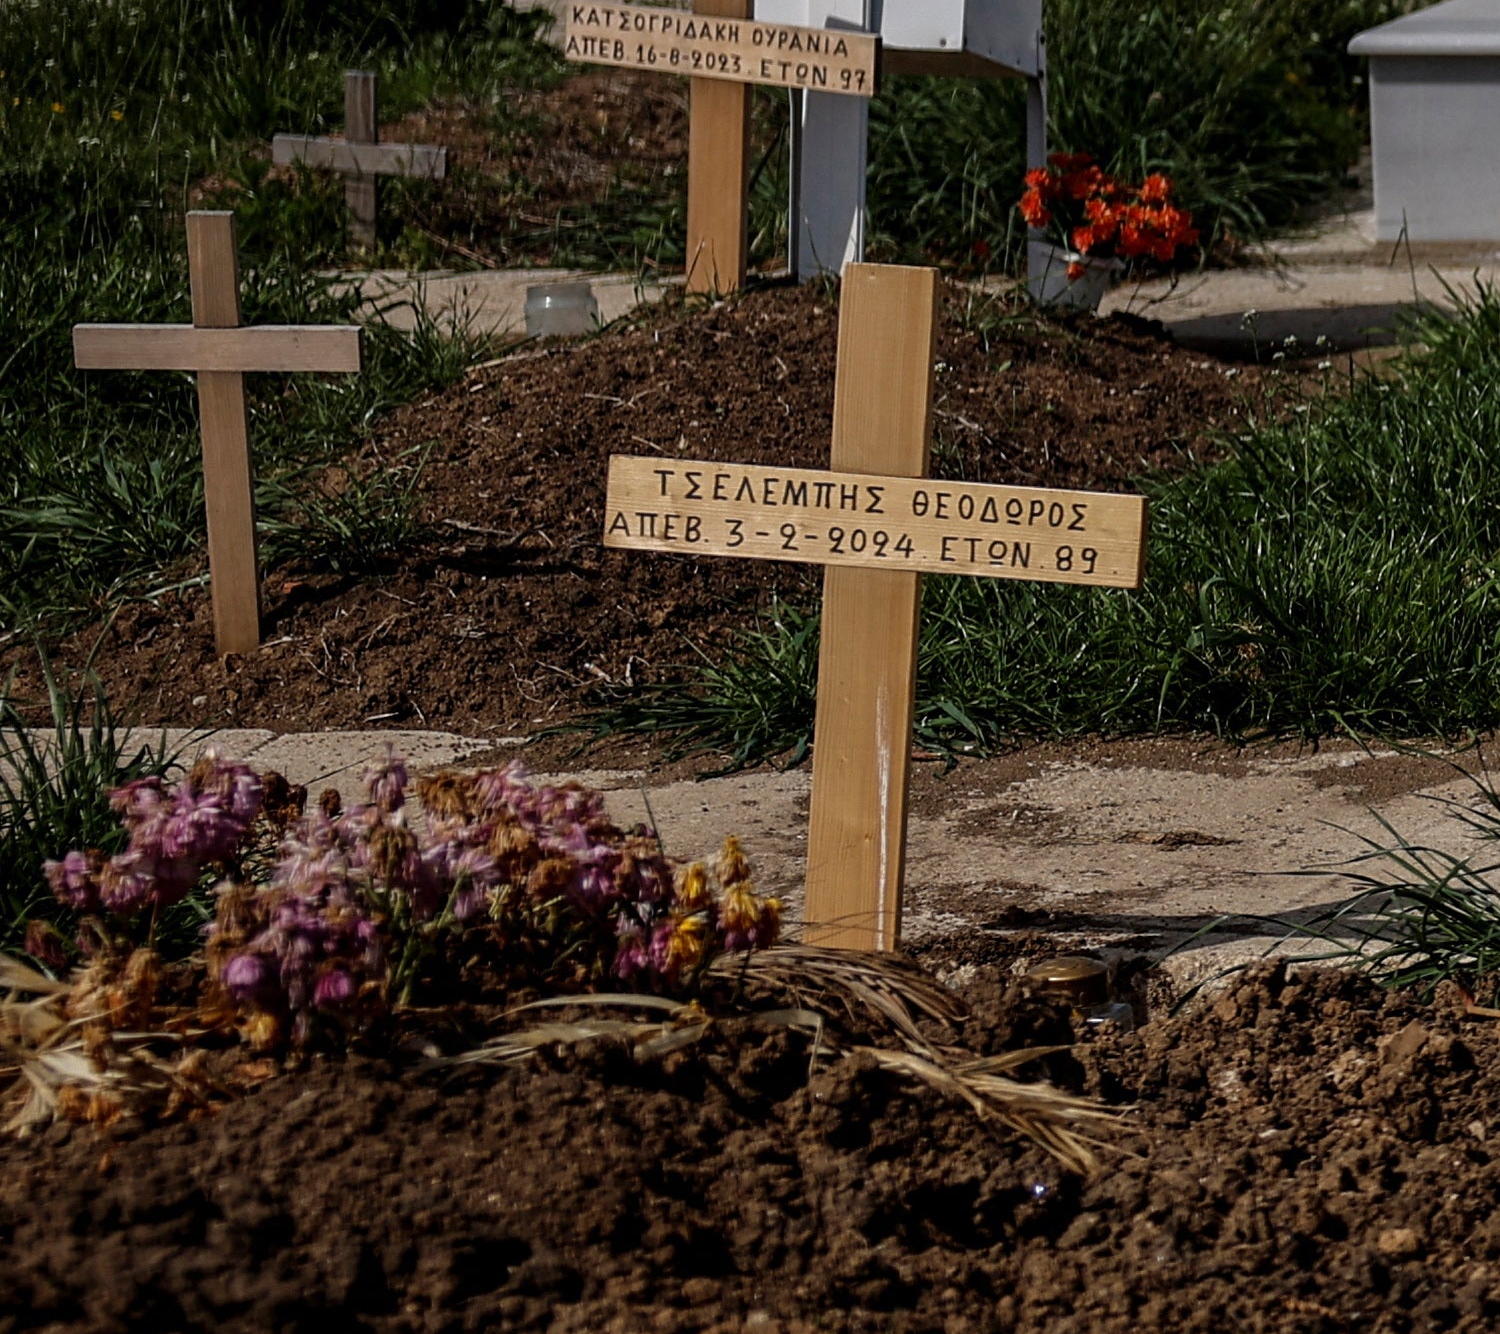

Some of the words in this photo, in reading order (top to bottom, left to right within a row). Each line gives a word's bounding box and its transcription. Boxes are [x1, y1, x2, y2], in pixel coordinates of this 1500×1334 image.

[573, 5, 740, 43] ΚΑΤΣΟΓΡΙΔΑΚΗ
[752, 27, 849, 58] ΟΥΡΑΝΙΑ
[839, 69, 867, 92] 97
[653, 469, 886, 514] ΤΣΕΛΕΜΠΗΣ
[911, 490, 1089, 532] ΘΕΟΔΩΡΟΣ
[608, 511, 710, 544] ΑΠΕΒ.
